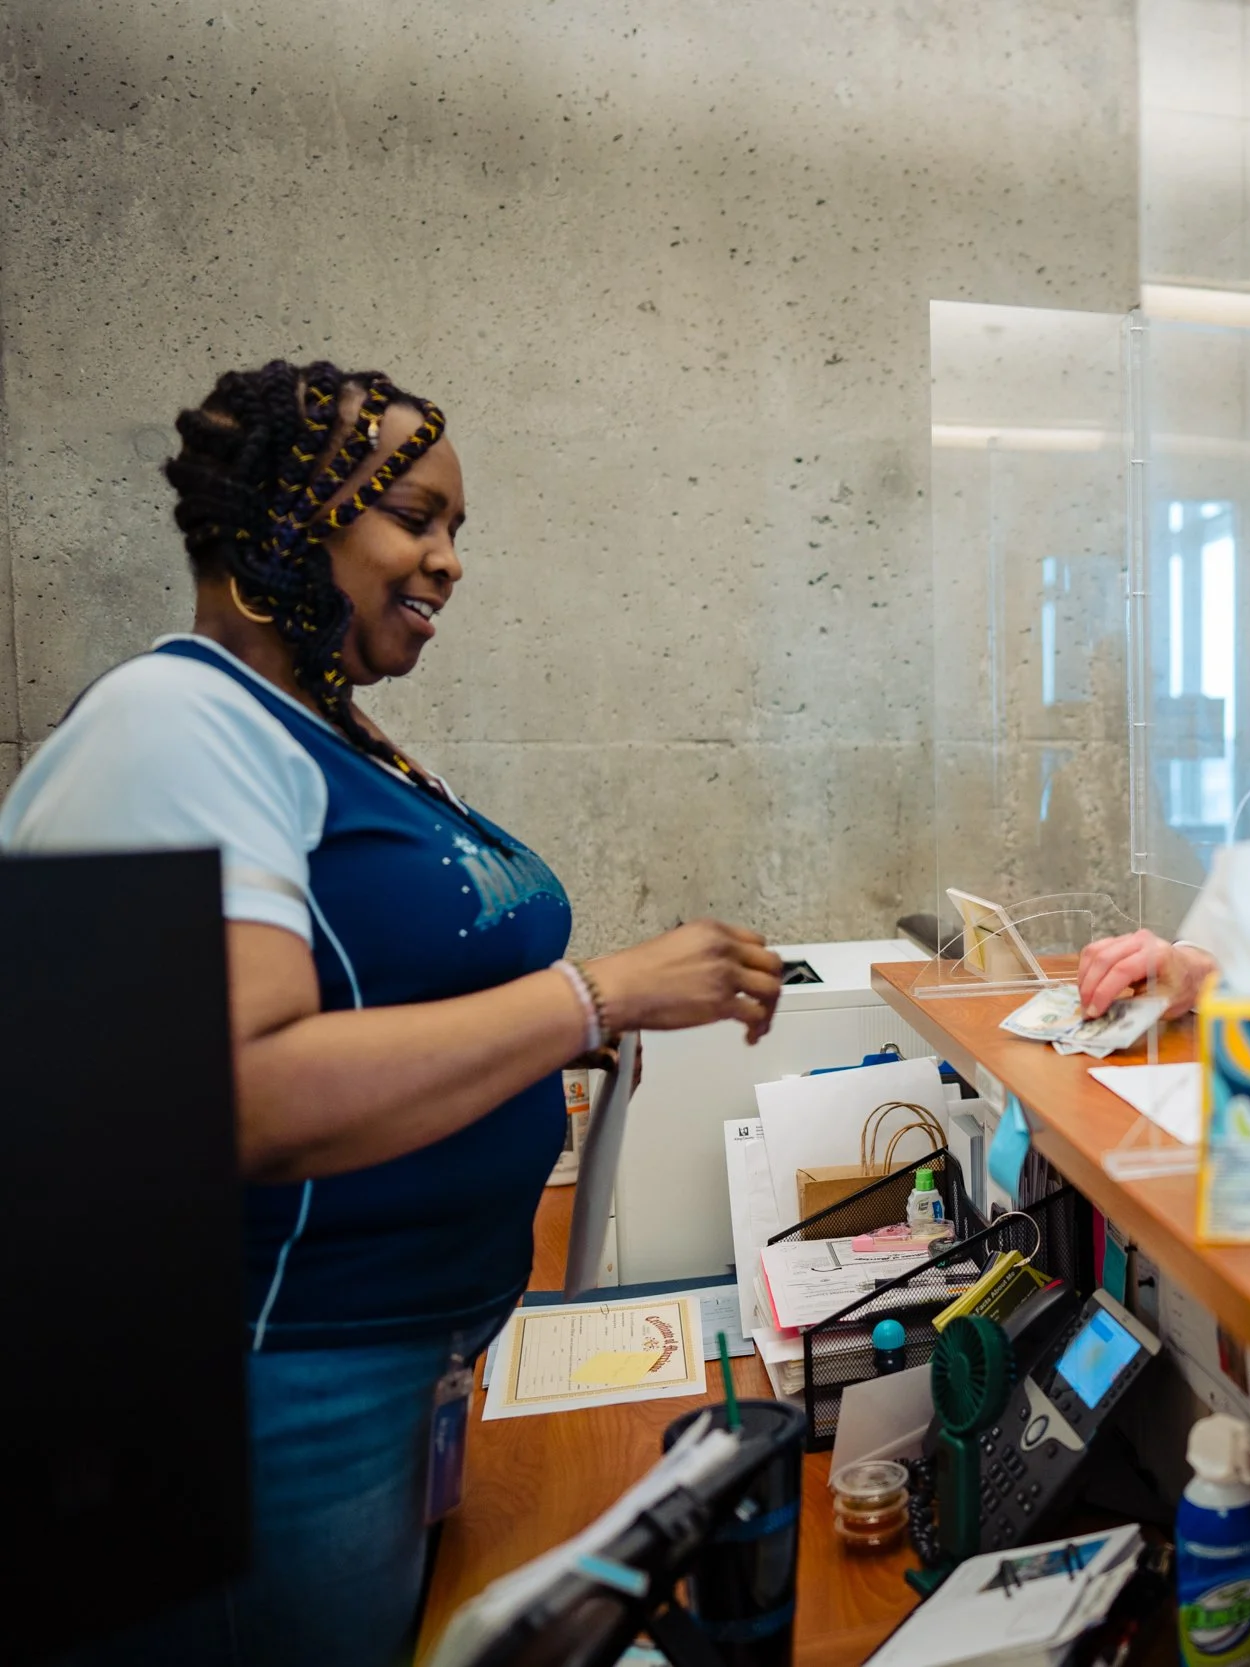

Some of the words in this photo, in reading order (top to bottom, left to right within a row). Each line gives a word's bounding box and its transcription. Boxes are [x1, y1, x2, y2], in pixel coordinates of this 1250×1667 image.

[974, 1297, 992, 1314] Facts
[990, 1281, 1008, 1299] About
[1006, 1270, 1016, 1281] Me
